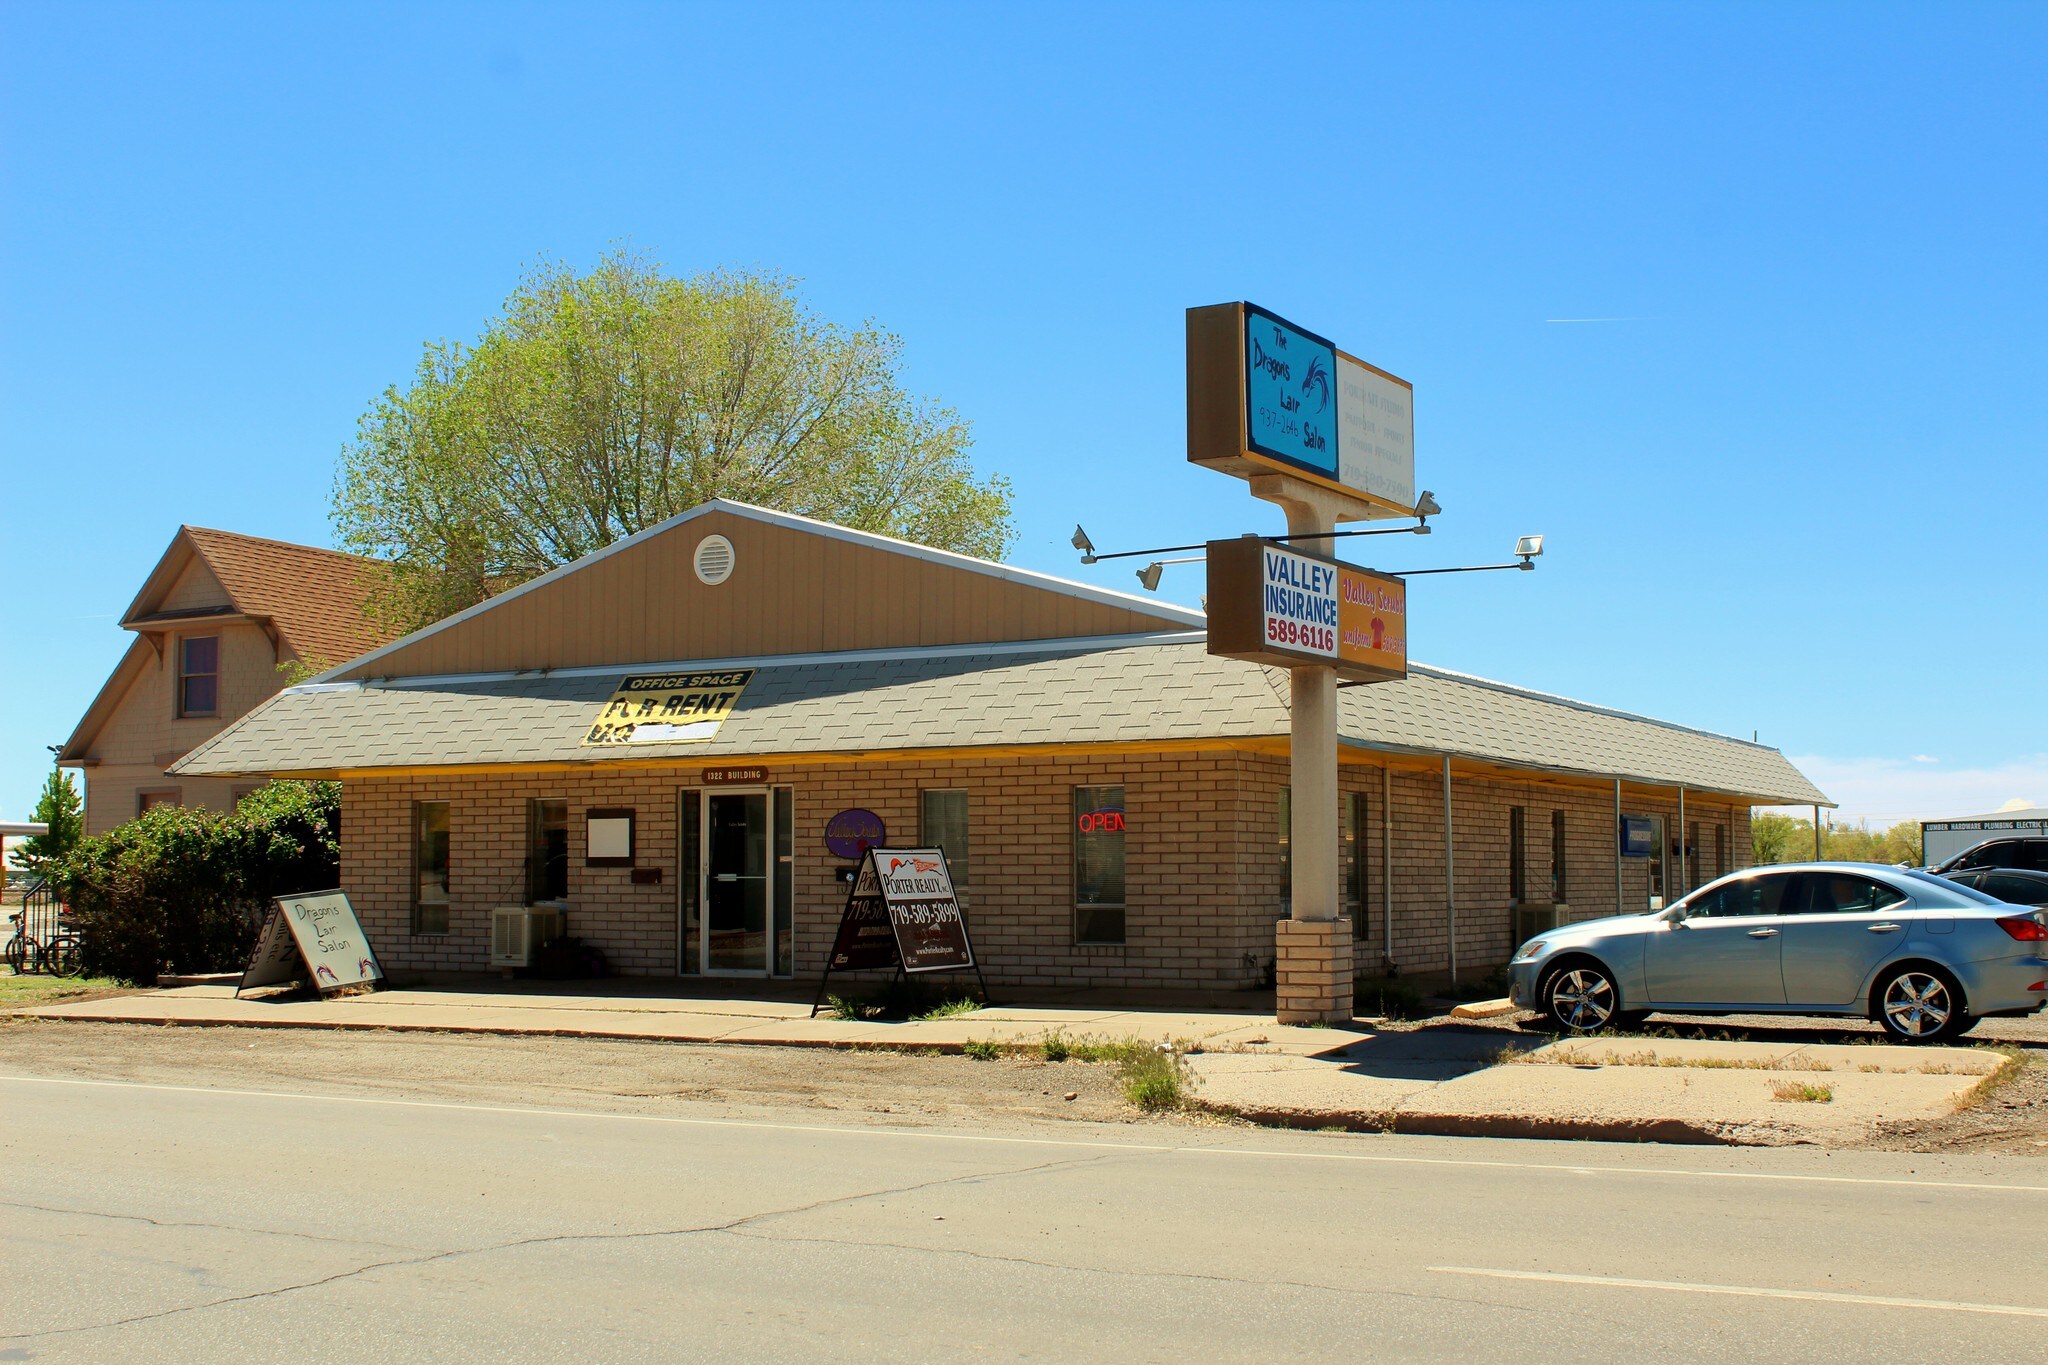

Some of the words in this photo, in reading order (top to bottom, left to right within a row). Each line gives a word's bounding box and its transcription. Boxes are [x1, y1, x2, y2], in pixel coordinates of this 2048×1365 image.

[1272, 327, 1288, 351] The
[1280, 387, 1301, 414] Lair
[1303, 421, 1327, 453] Salon
[1266, 553, 1334, 596] VALLEY
[1265, 584, 1337, 627] INSURANCE
[1343, 578, 1376, 614] Valley
[630, 677, 686, 690] OFFICE
[689, 673, 744, 687] SPACE
[659, 692, 735, 717] RENT
[707, 771, 723, 781] 1322
[727, 770, 761, 781] BUILDING
[1079, 812, 1126, 832] OPEN
[1926, 823, 1949, 831] LUMBER
[1950, 822, 1982, 830] HARDWARE
[1984, 821, 2014, 829] PLUMBING
[882, 873, 916, 895] PORTER
[889, 902, 959, 925] 719-589-5899
[313, 922, 338, 938] Lair
[317, 938, 352, 954] Salon
